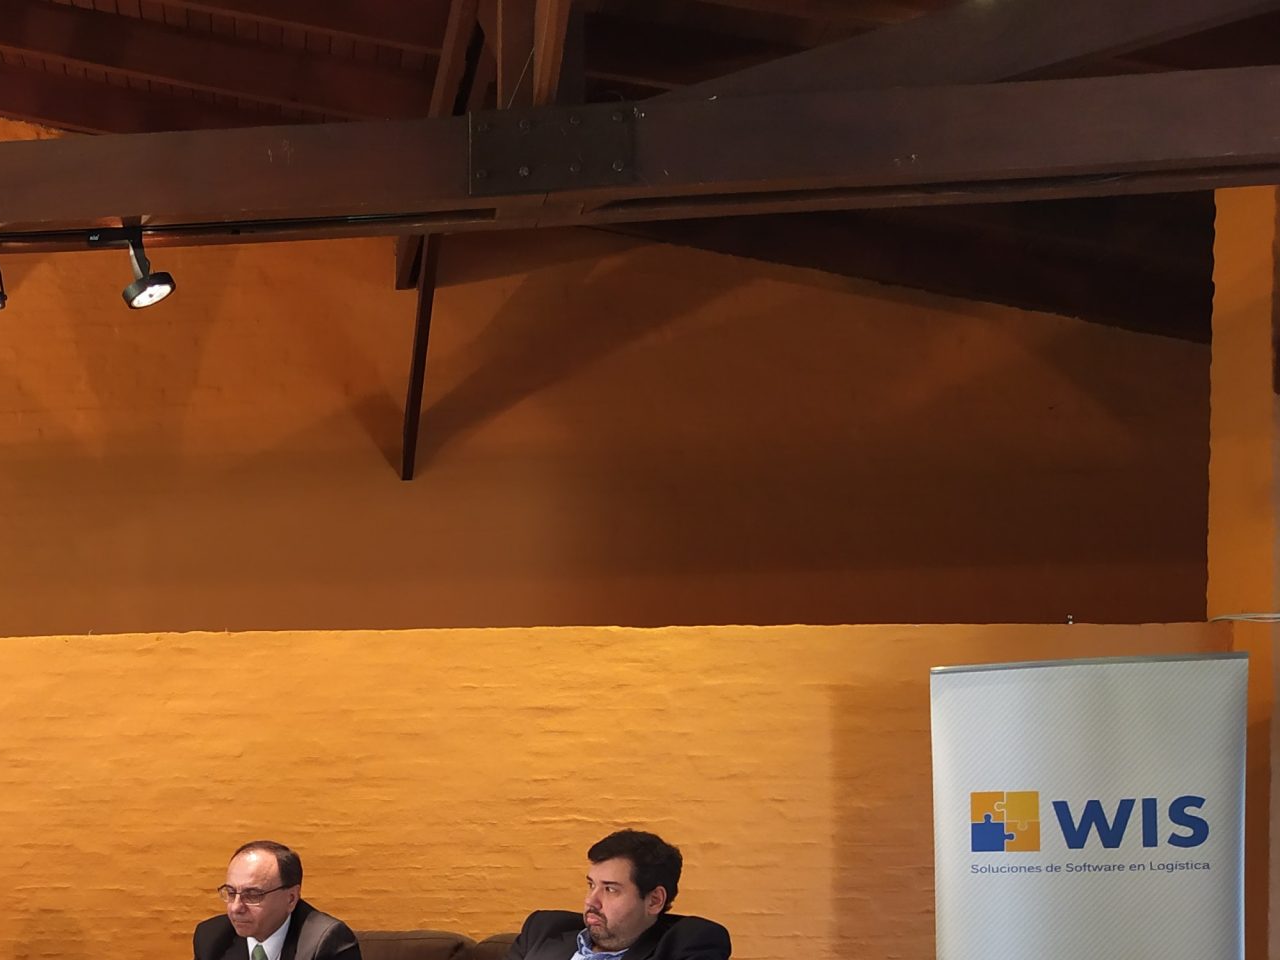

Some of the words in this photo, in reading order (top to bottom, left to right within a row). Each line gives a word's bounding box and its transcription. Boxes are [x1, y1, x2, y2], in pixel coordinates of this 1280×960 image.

[1052, 795, 1210, 850] WIS
[970, 864, 1042, 874] Soluciones
[1045, 863, 1061, 873] de
[1065, 862, 1125, 873] Software
[1129, 863, 1146, 871] en
[1149, 861, 1211, 873] Logística
